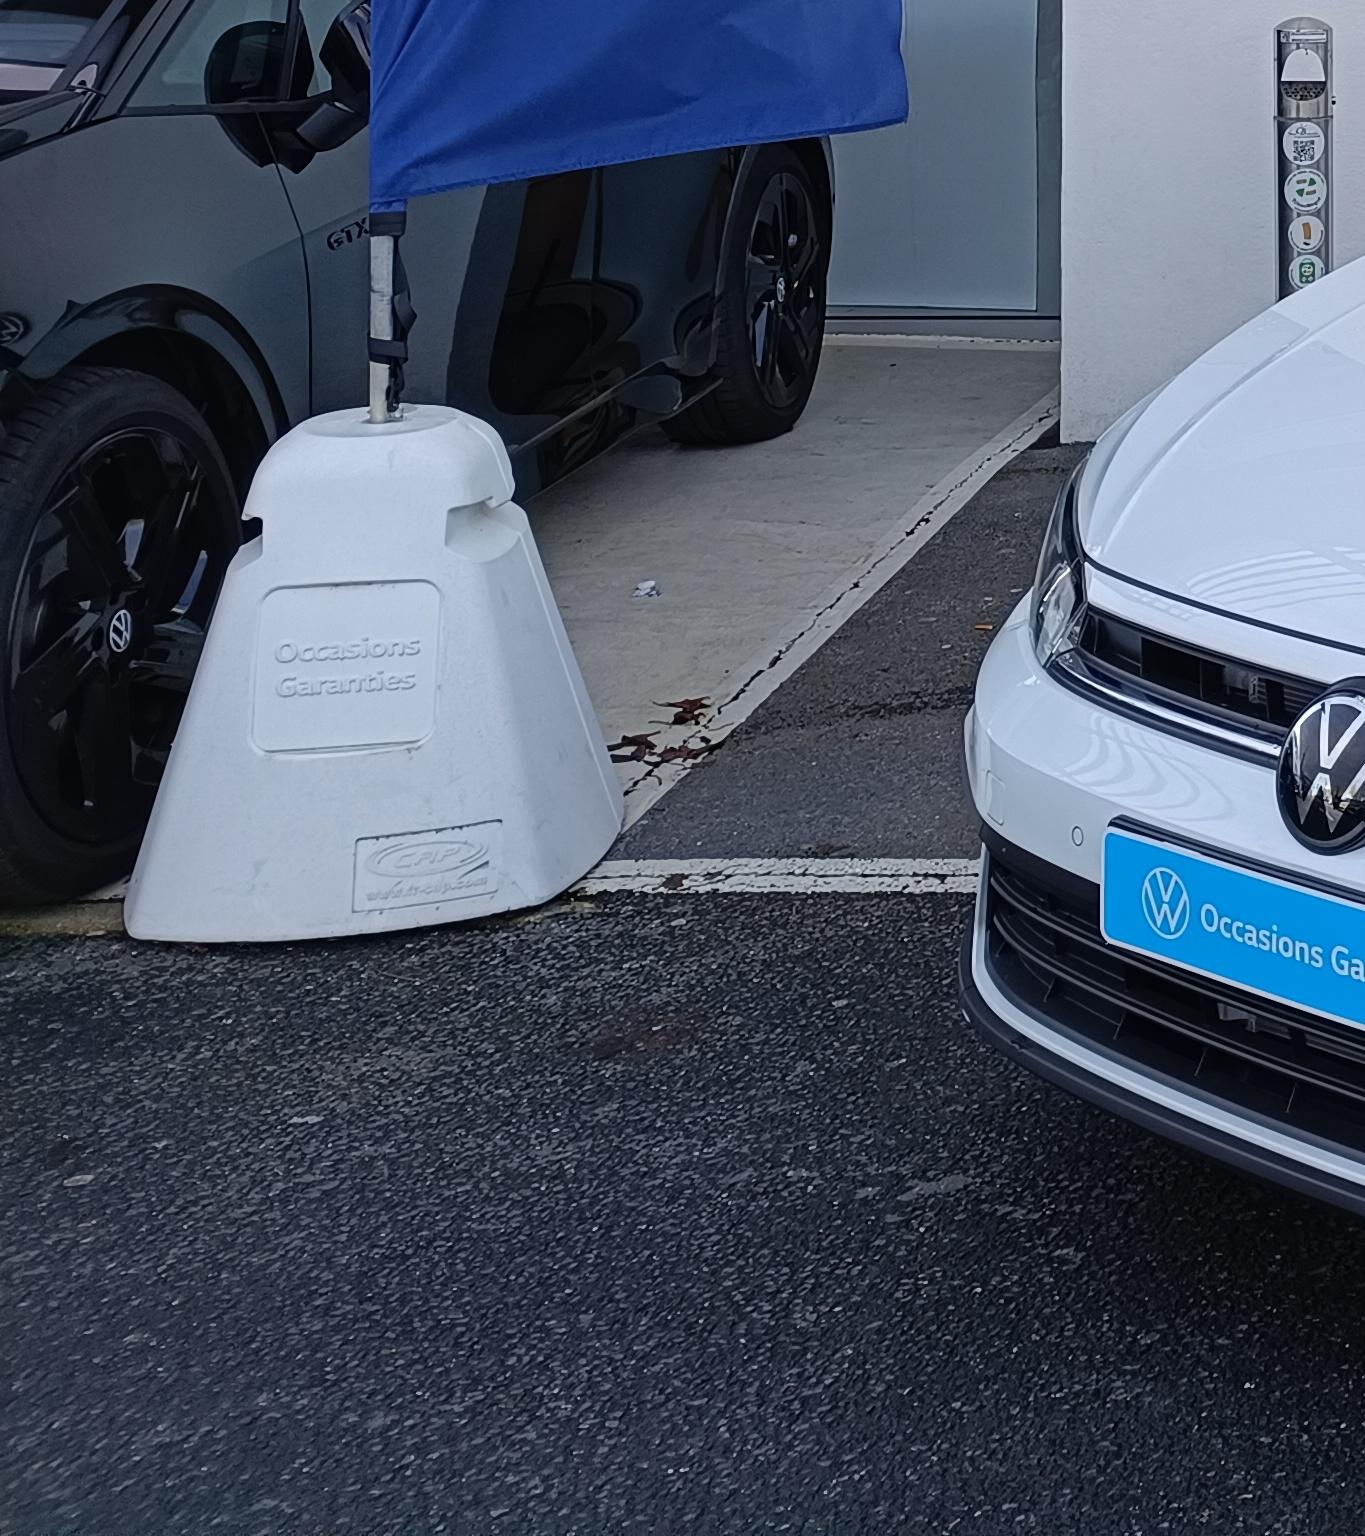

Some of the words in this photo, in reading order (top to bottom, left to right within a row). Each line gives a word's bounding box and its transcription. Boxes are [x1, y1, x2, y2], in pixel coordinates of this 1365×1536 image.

[327, 217, 369, 251] GTX
[274, 637, 421, 664] Occasions
[275, 671, 417, 698] Garanties
[1200, 902, 1325, 969] Occasions
